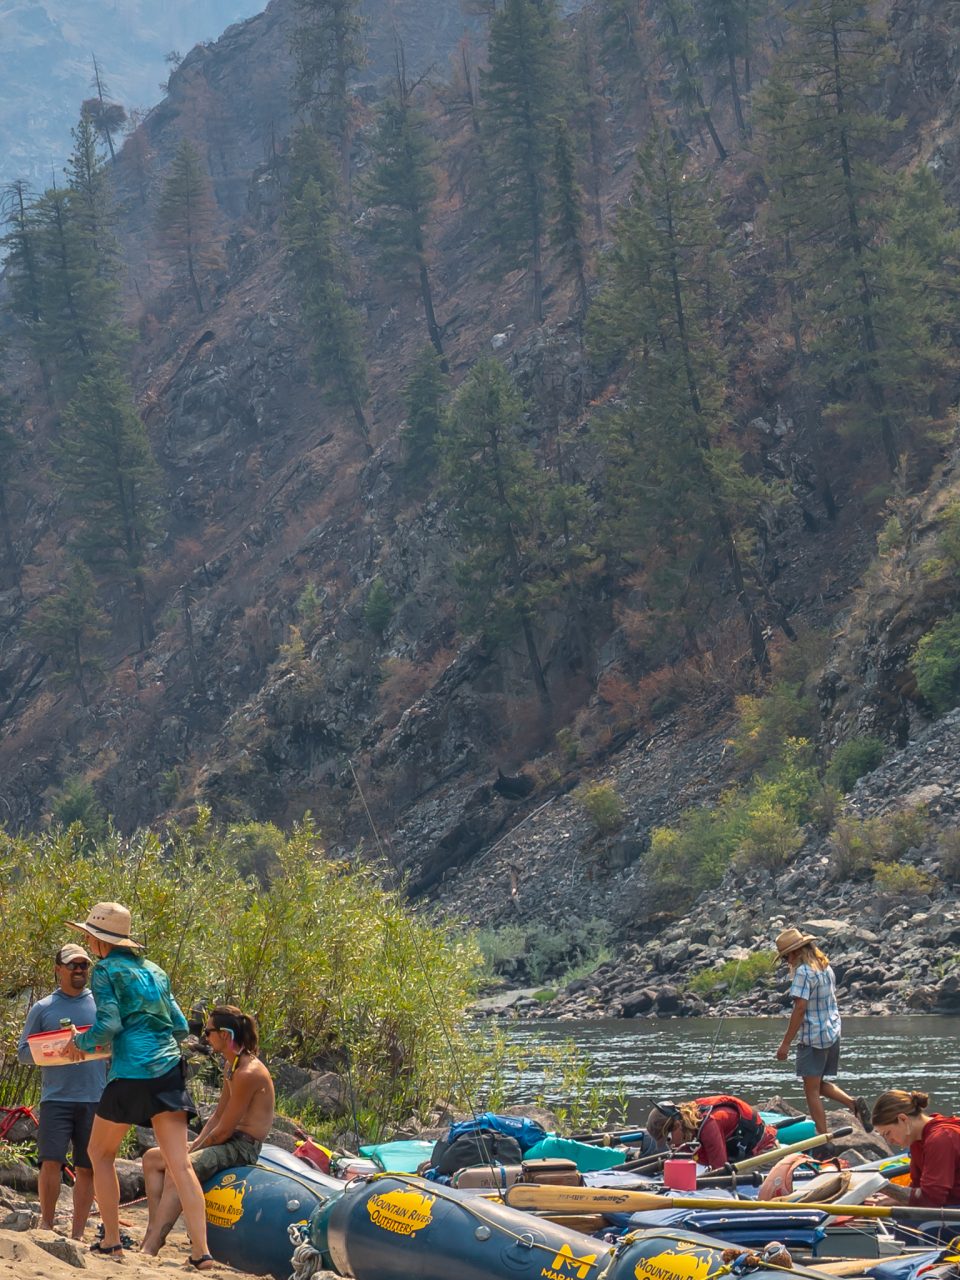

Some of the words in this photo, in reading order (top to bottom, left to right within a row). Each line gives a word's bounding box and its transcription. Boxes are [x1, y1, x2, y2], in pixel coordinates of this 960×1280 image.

[369, 1195, 409, 1217] MOUNTAIN
[408, 1209, 432, 1223] RIVER
[371, 1209, 414, 1233] OUTFITTERS
